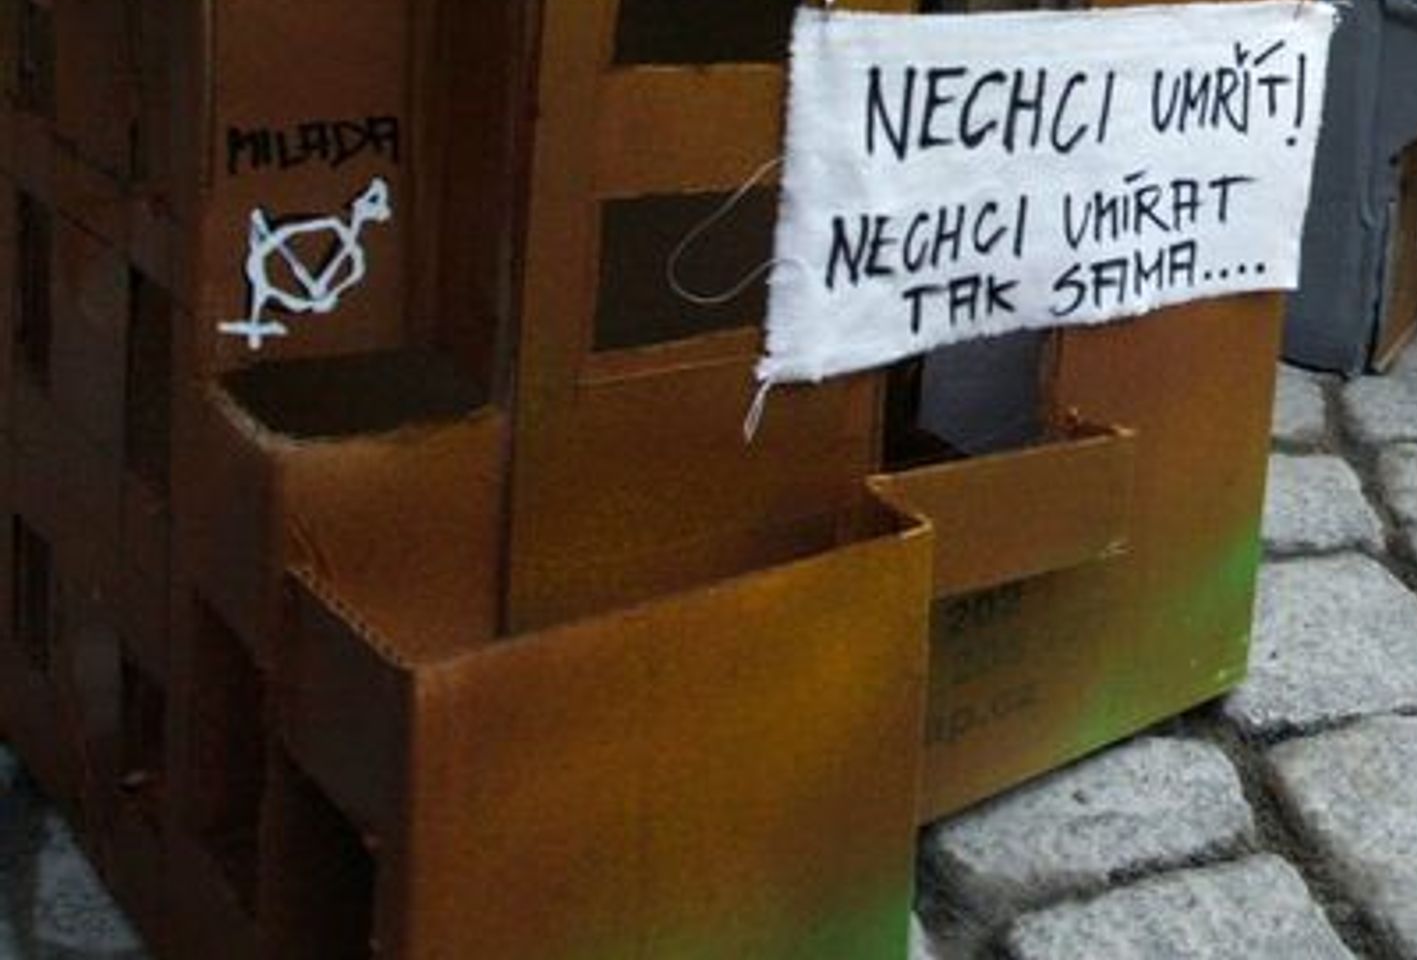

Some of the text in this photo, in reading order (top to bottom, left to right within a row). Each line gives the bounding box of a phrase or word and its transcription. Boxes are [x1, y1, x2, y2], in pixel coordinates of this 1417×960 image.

[227, 116, 400, 175] MILADA
[864, 66, 1116, 160] NECHCI
[825, 171, 1255, 291] NECHCI UMÍRAT
[903, 275, 1018, 333] TAK
